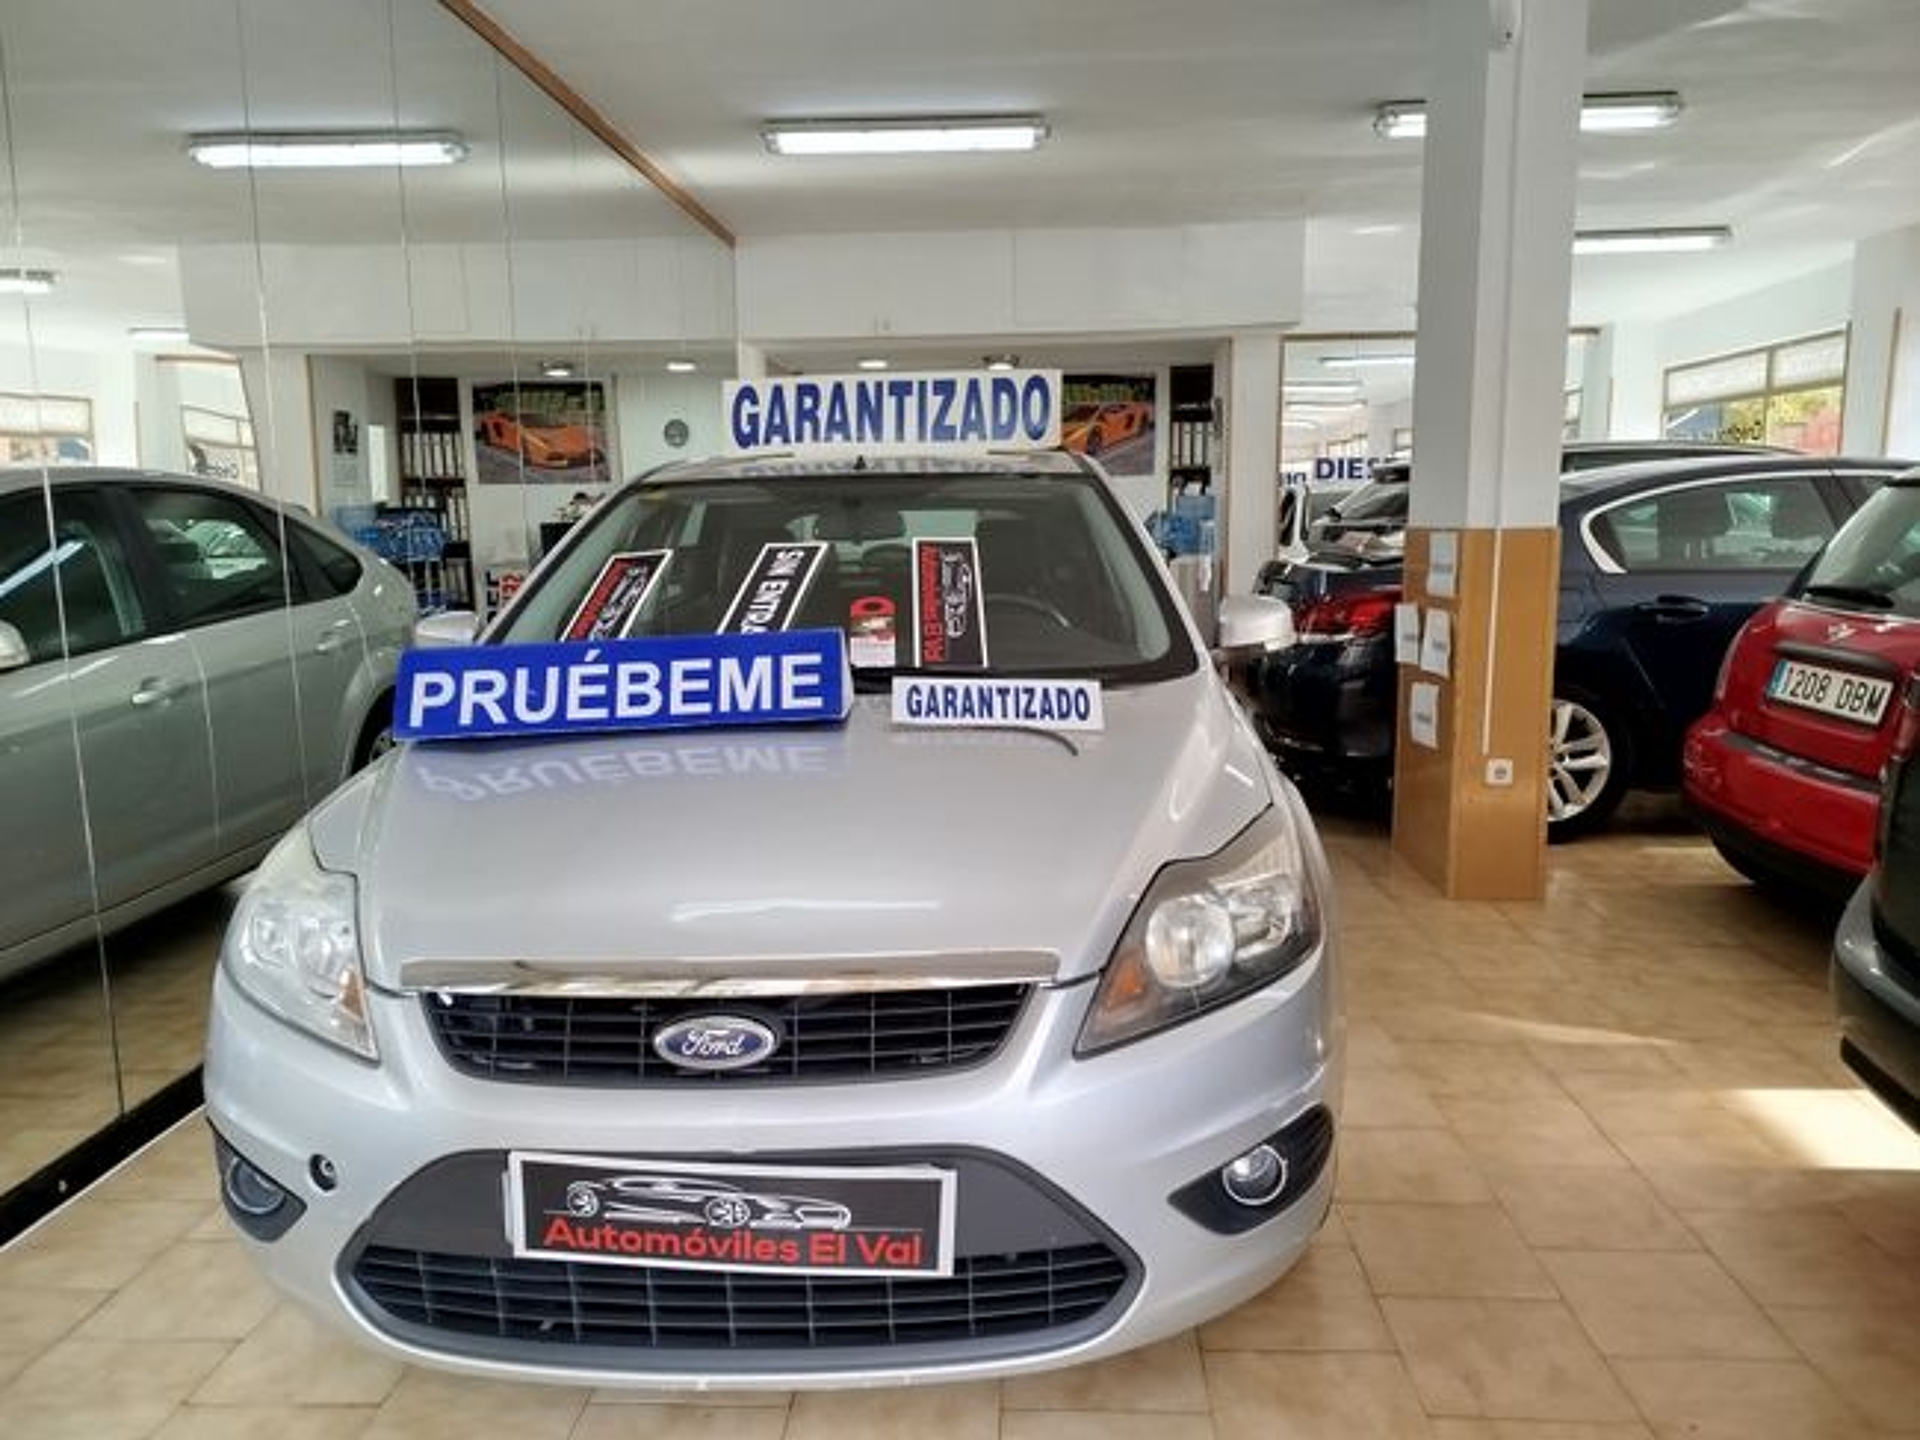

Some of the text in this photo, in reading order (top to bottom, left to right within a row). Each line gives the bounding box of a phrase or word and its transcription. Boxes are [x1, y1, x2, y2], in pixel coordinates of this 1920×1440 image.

[731, 374, 1051, 448] GARANTIZADO
[408, 649, 823, 728] PRUÉBEME
[906, 684, 1091, 721] GARANTIZADO
[1781, 666, 1888, 719] 1208 DBM
[682, 1029, 746, 1056] Ford
[543, 1217, 921, 1266] Automóviles El Val
